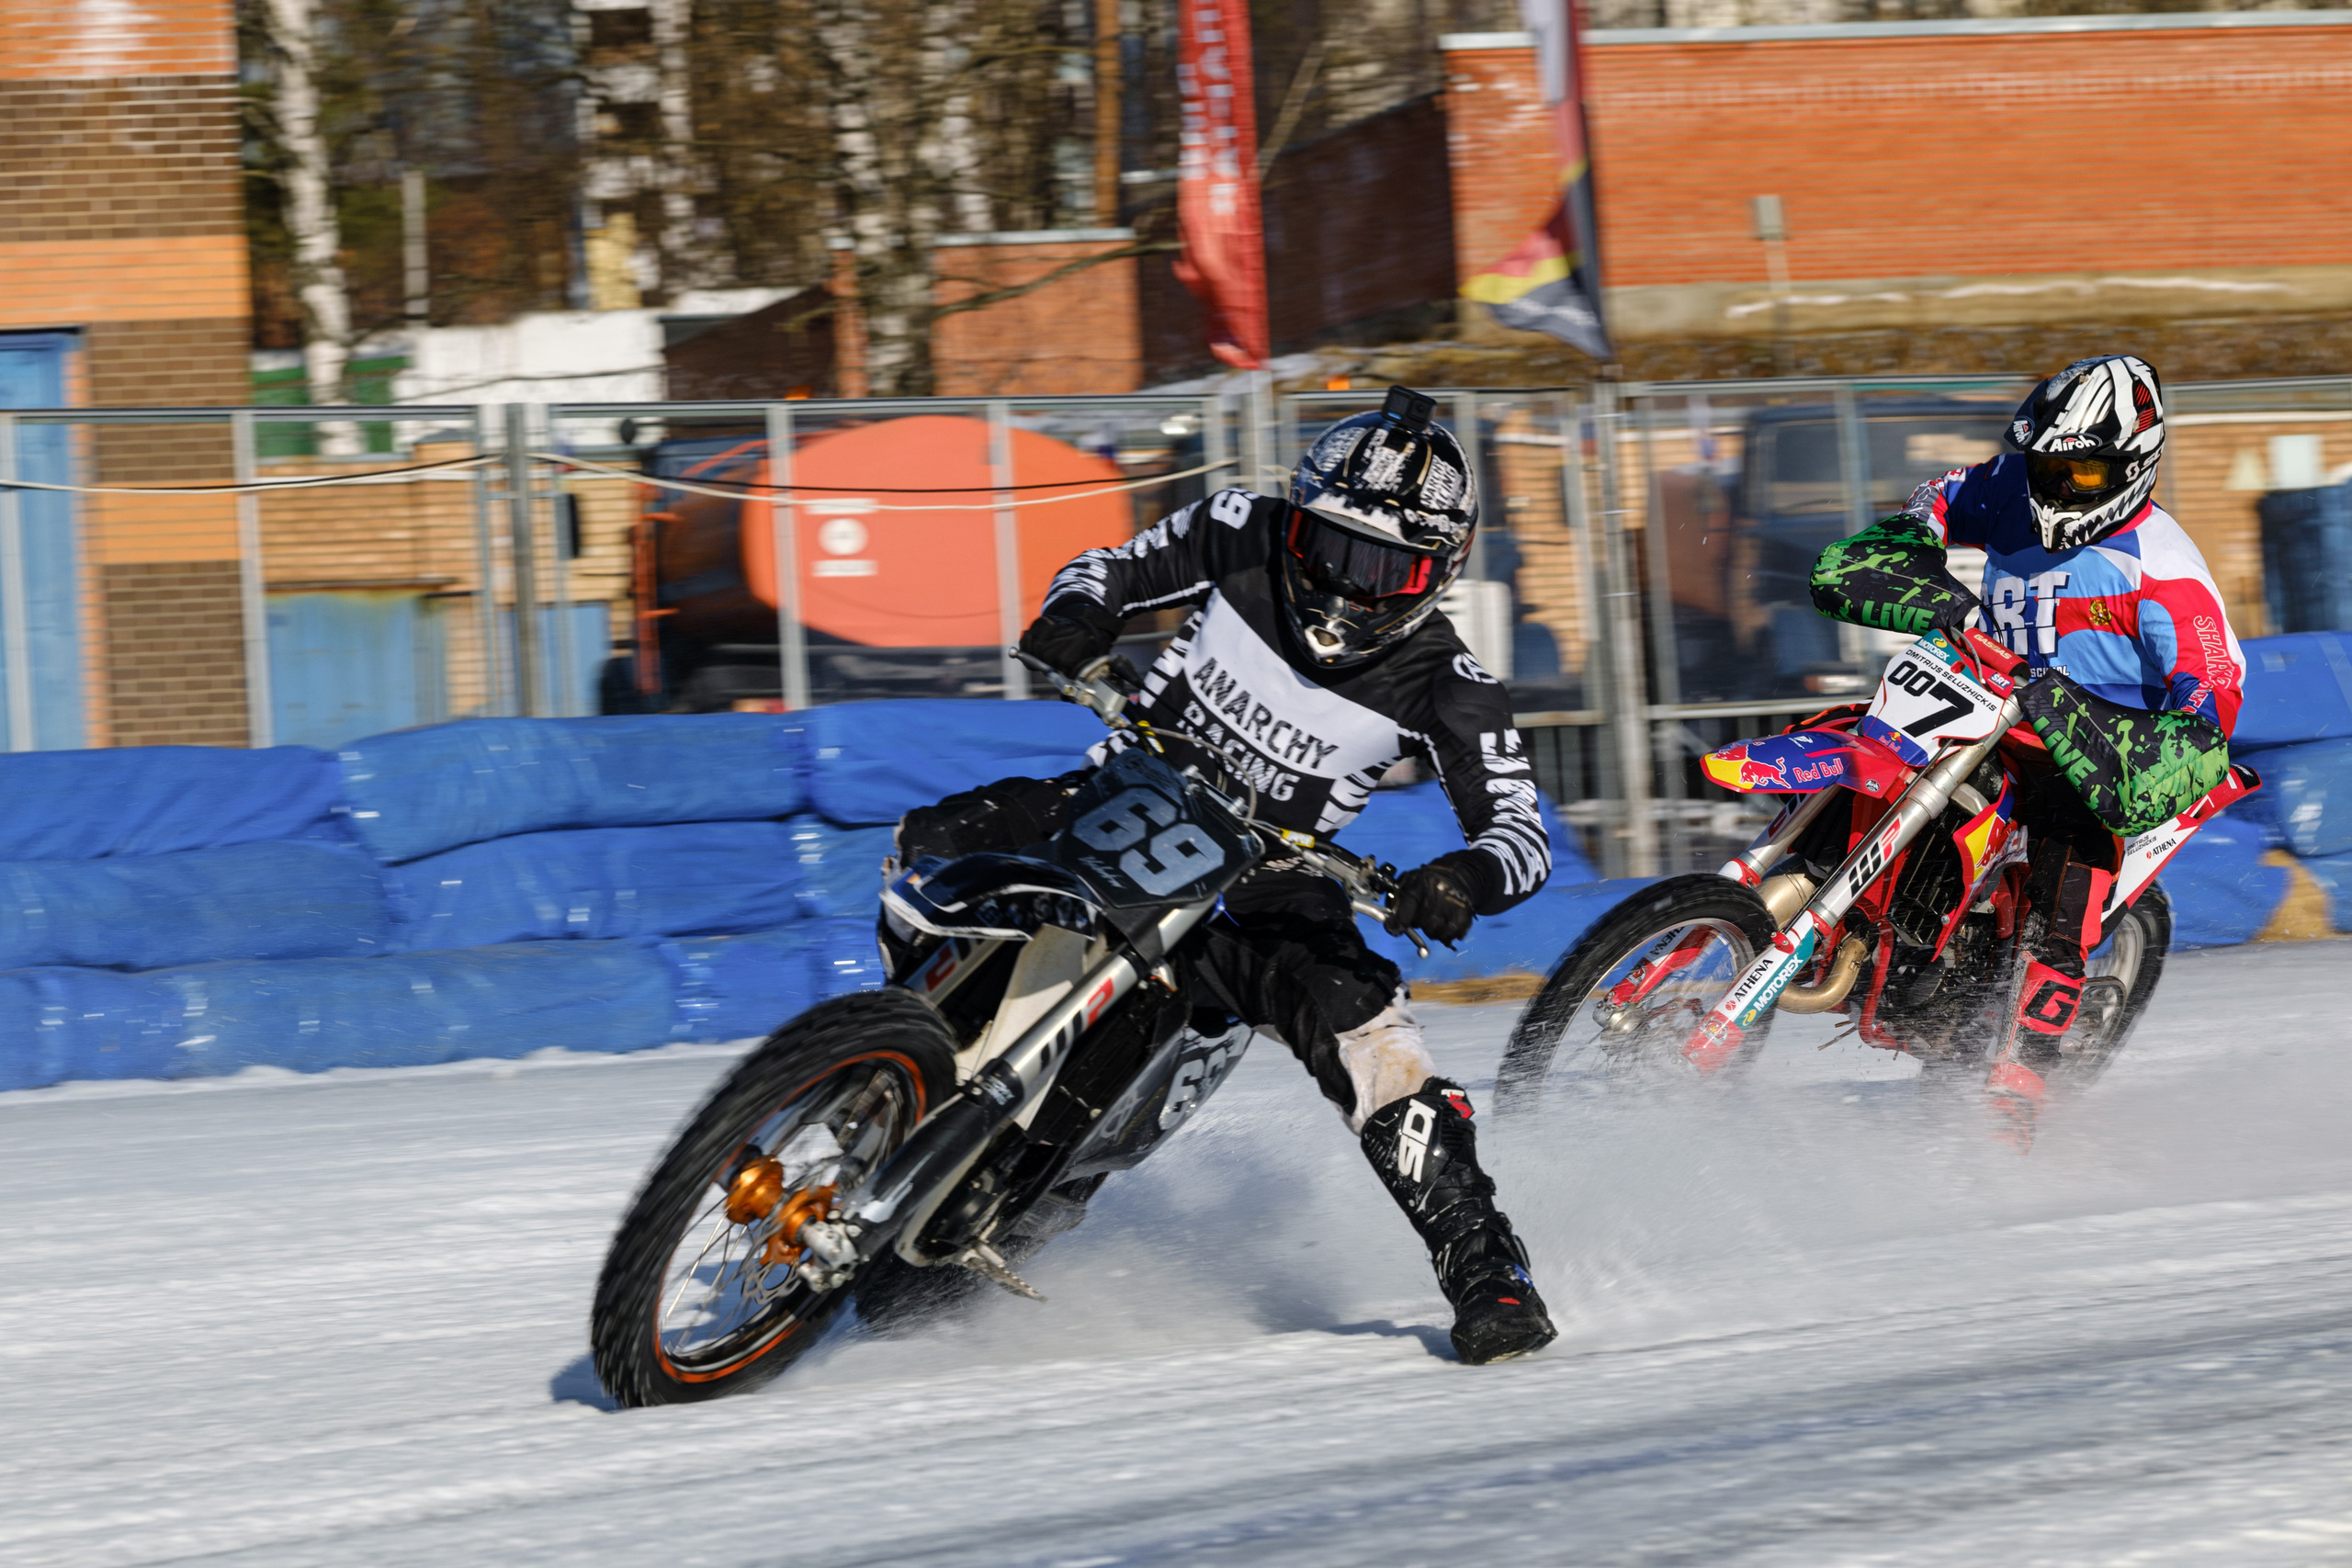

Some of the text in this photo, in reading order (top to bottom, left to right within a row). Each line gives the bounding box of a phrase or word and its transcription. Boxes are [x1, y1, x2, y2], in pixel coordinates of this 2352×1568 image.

[2049, 434, 2097, 453] Airoh
[1917, 638, 1950, 661] MOTOREX
[1973, 634, 2012, 660] GASGAS
[1887, 660, 1974, 738] 007
[1905, 649, 1996, 712] DMITRIJS SELUZHICKIS
[1193, 656, 1340, 770] ANARCHY
[1175, 699, 1301, 802] RACING
[1792, 758, 1844, 783] Red Bull
[1071, 787, 1226, 897] 69
[2153, 838, 2177, 858] ATHENA
[1650, 926, 1685, 956] THENA
[1735, 958, 1774, 1002] ATHENA
[1755, 954, 1804, 1011] MOTOREX
[1397, 1098, 1437, 1183] SIDI
